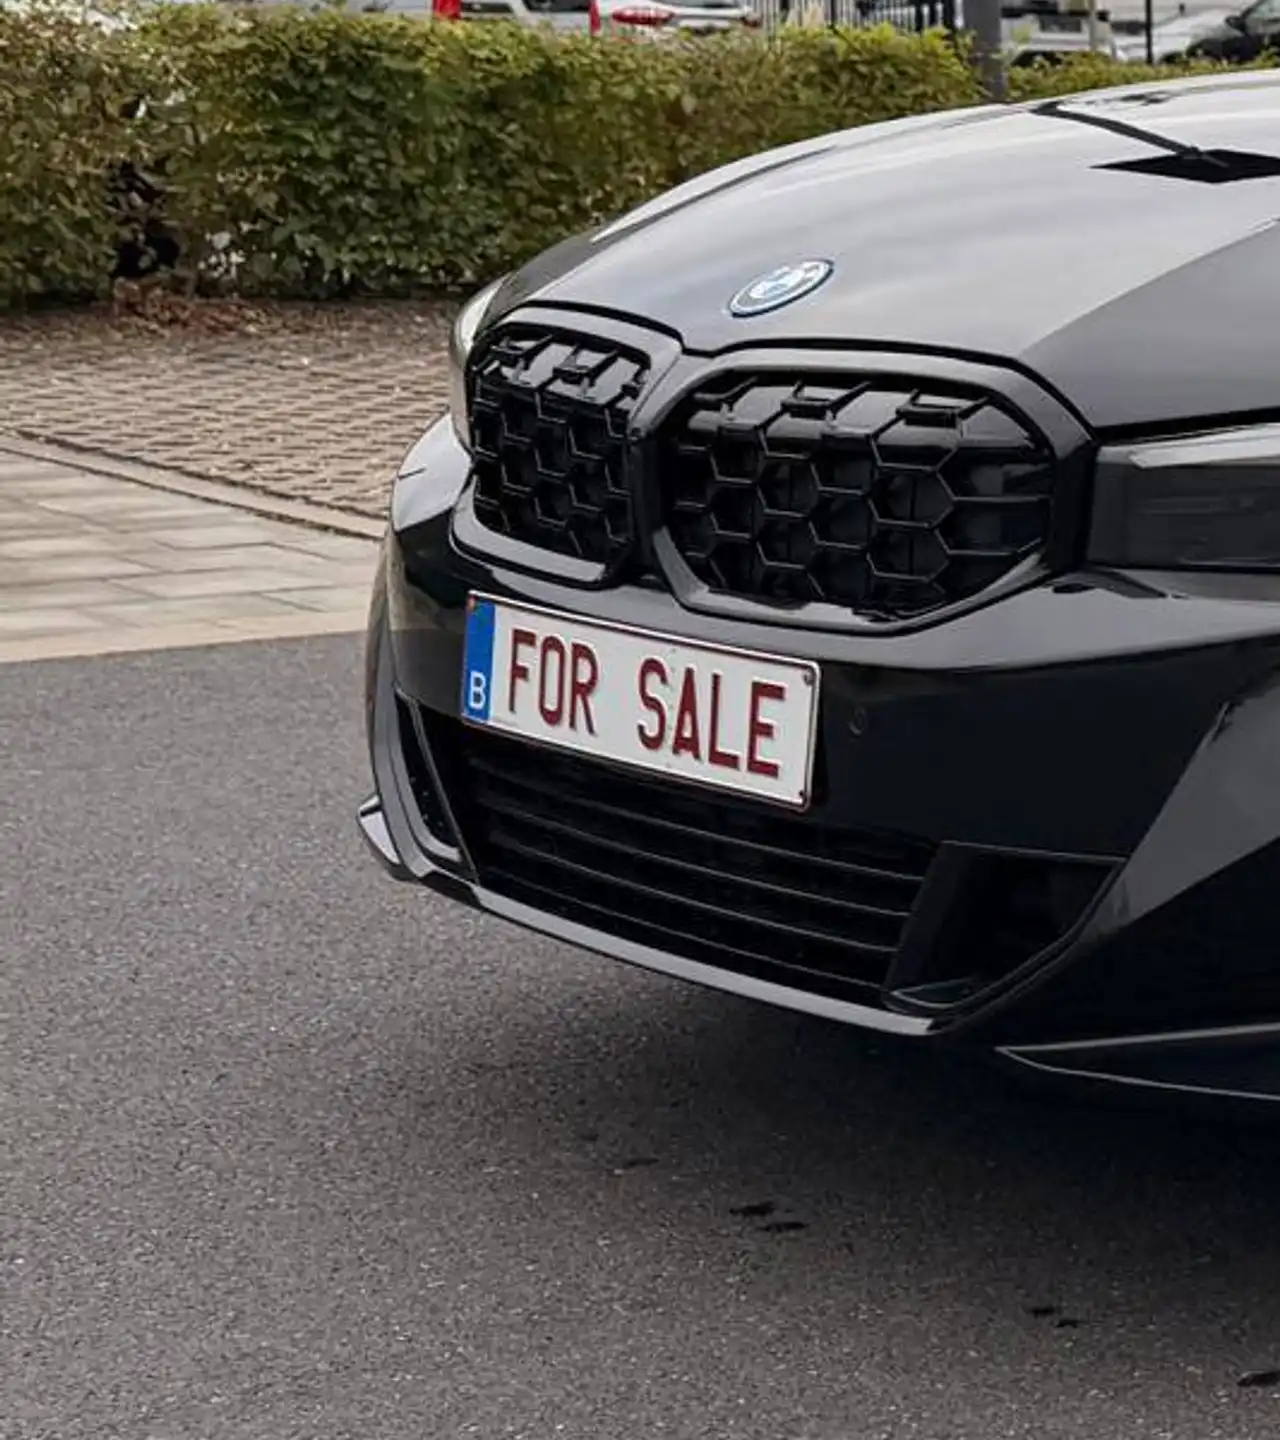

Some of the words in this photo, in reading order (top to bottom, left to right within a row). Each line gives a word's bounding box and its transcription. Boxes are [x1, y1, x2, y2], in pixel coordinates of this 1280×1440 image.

[468, 670, 487, 711] B
[508, 627, 599, 736] FOR
[637, 657, 785, 779] SALE
